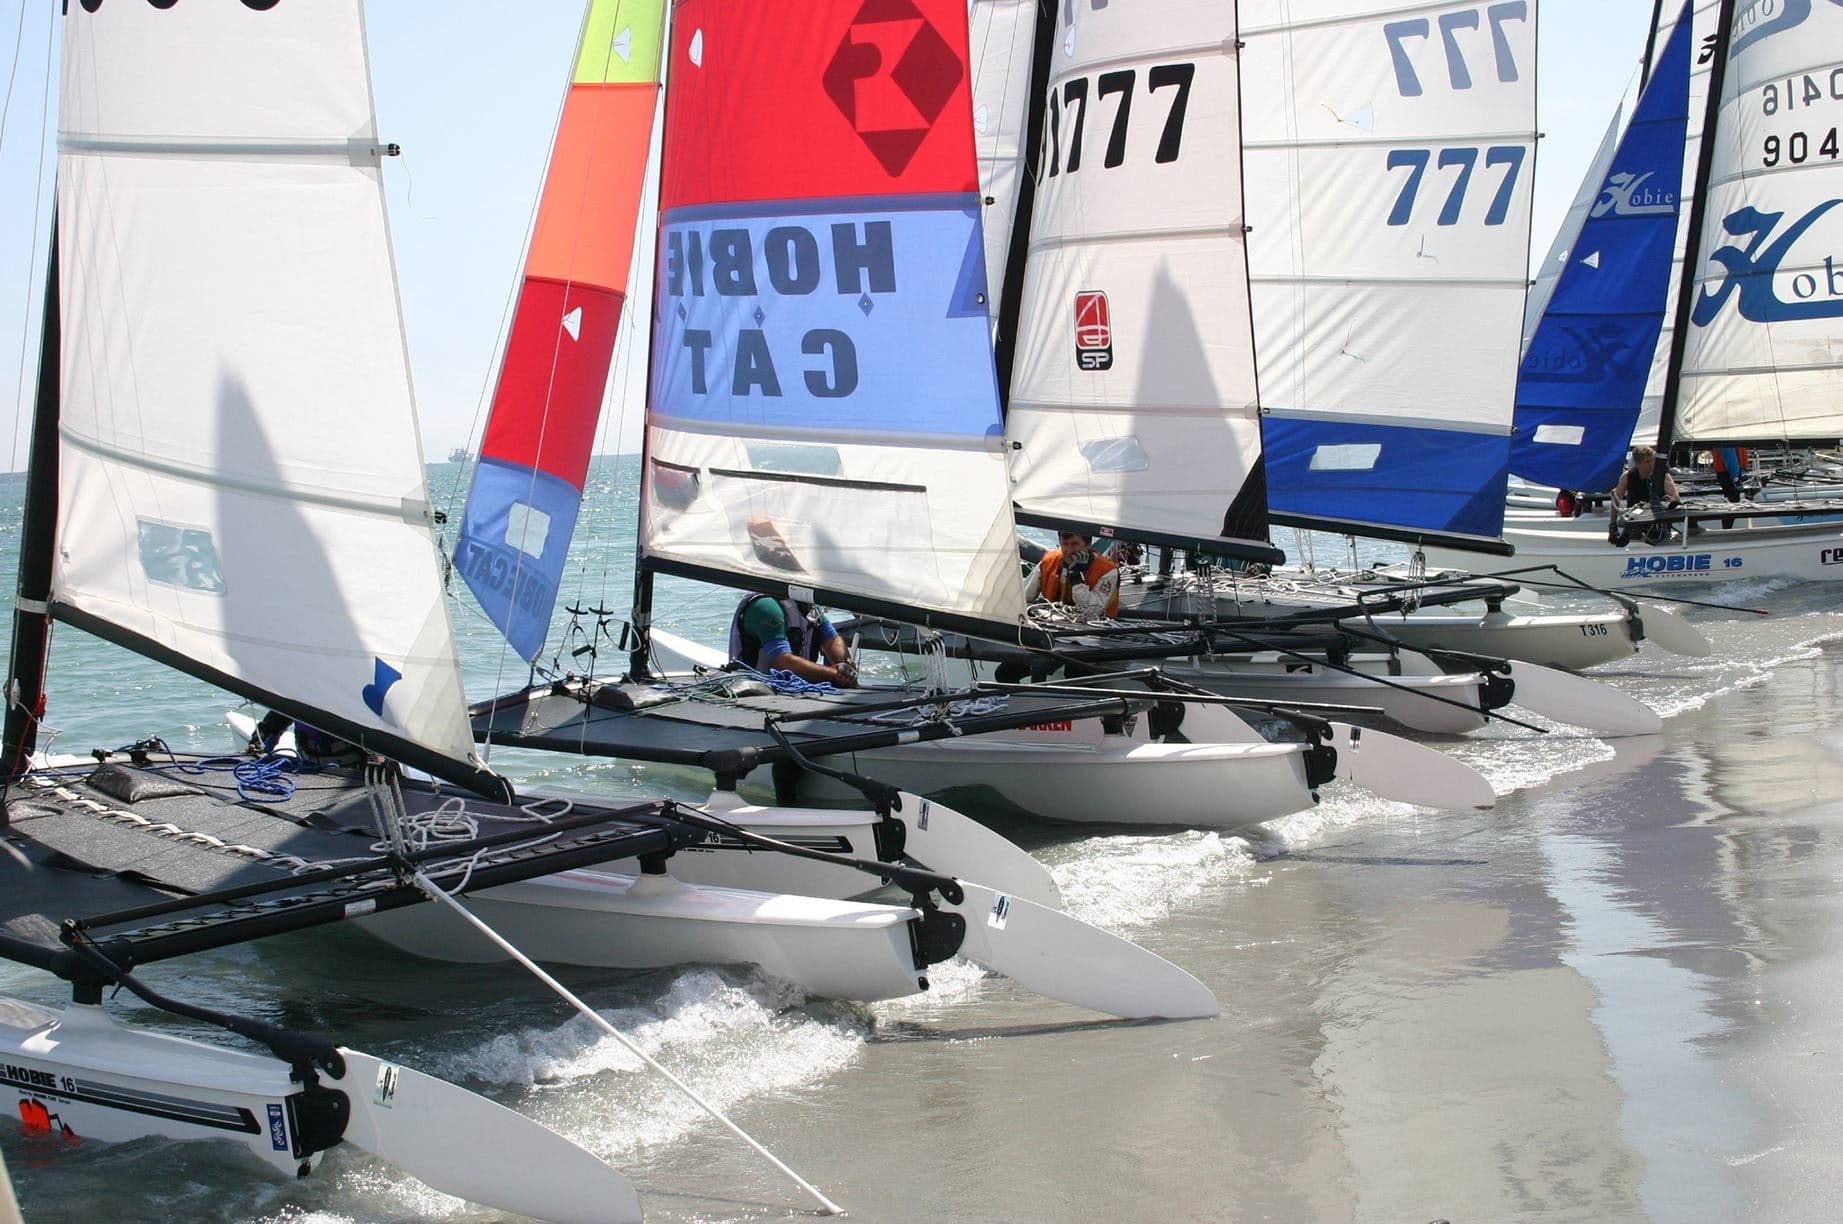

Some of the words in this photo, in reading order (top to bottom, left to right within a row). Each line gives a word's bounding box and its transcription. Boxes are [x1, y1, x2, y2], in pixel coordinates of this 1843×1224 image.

[1386, 146, 1526, 226] 777
[1082, 352, 1109, 368] SP
[1626, 554, 1712, 571] HOBIE
[1723, 557, 1743, 567] 16
[6, 1064, 57, 1089] HOBIE
[60, 1076, 76, 1092] 16
